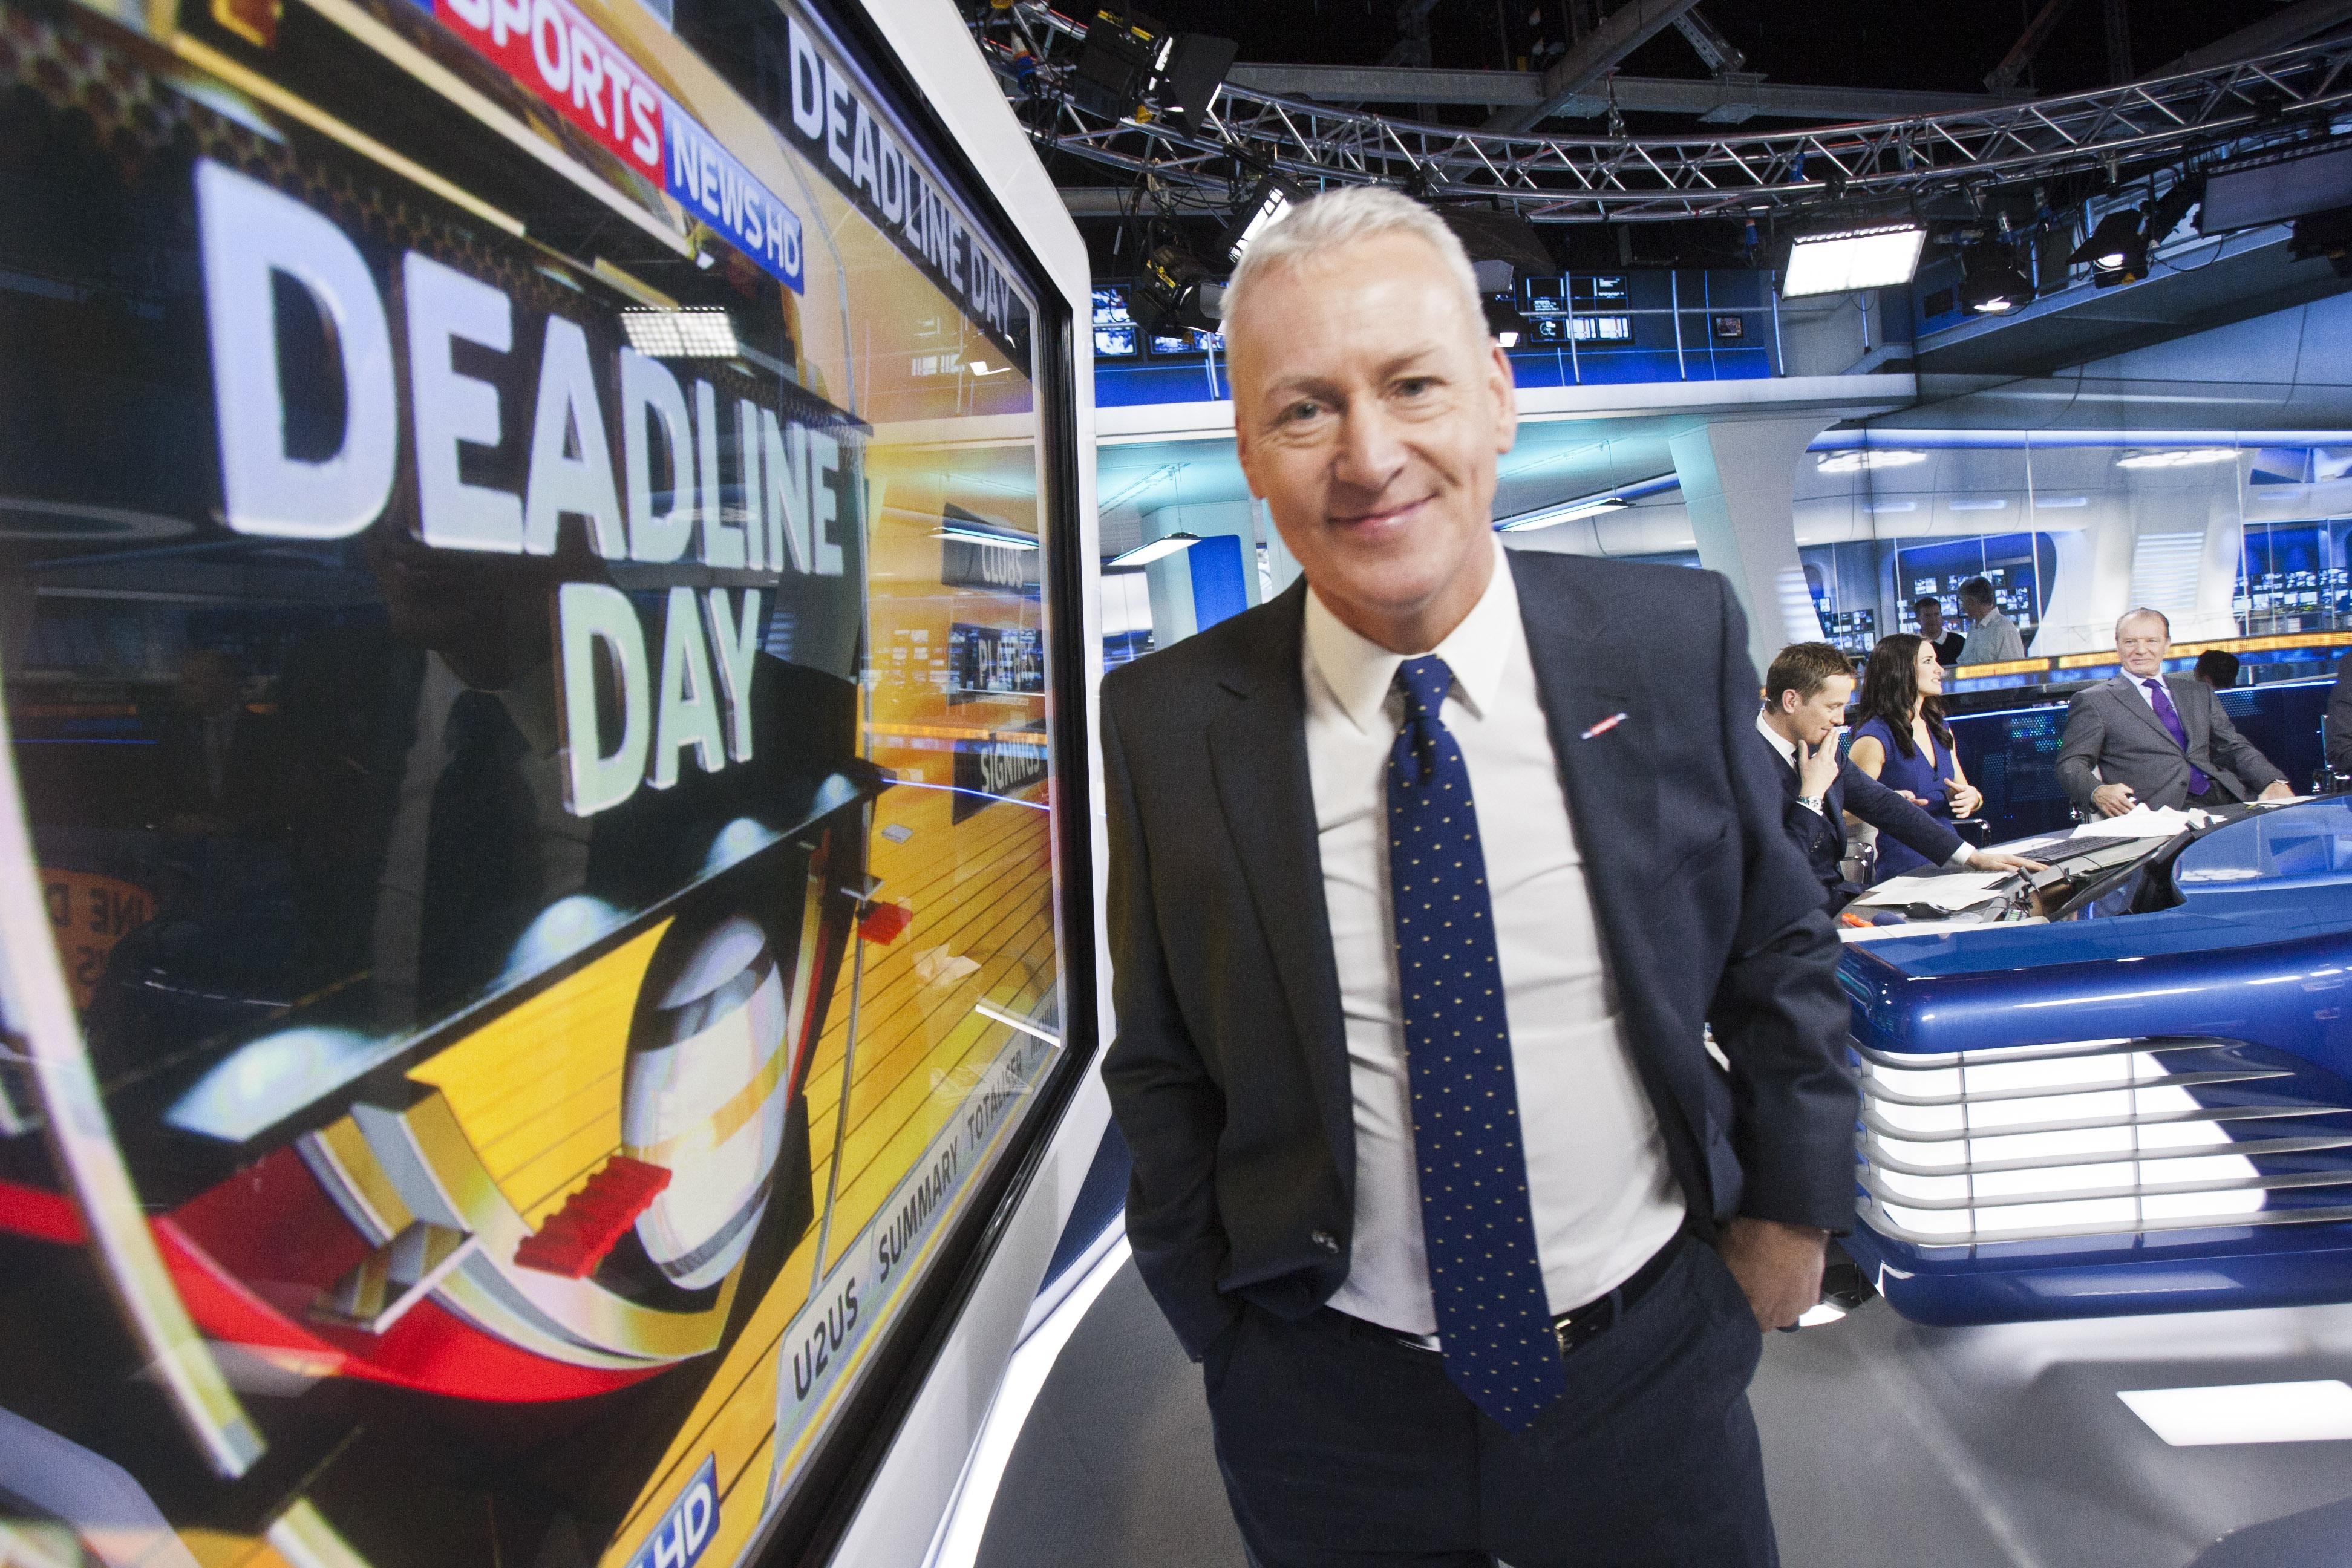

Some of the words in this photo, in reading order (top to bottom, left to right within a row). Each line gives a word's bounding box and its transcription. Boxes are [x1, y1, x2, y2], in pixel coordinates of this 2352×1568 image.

[673, 118, 763, 250] NEWS
[766, 204, 802, 278] HD
[788, 16, 965, 295] DEADLINE
[970, 240, 1011, 336] DAY
[192, 157, 844, 576] DEADLINE
[981, 540, 1023, 590] CLUBS
[557, 581, 762, 818] DAY
[981, 735, 1040, 793] SIGNINGS
[793, 1276, 859, 1402] U2US
[878, 1135, 958, 1284] SUMMARY
[967, 1048, 1024, 1151] TOTALISER
